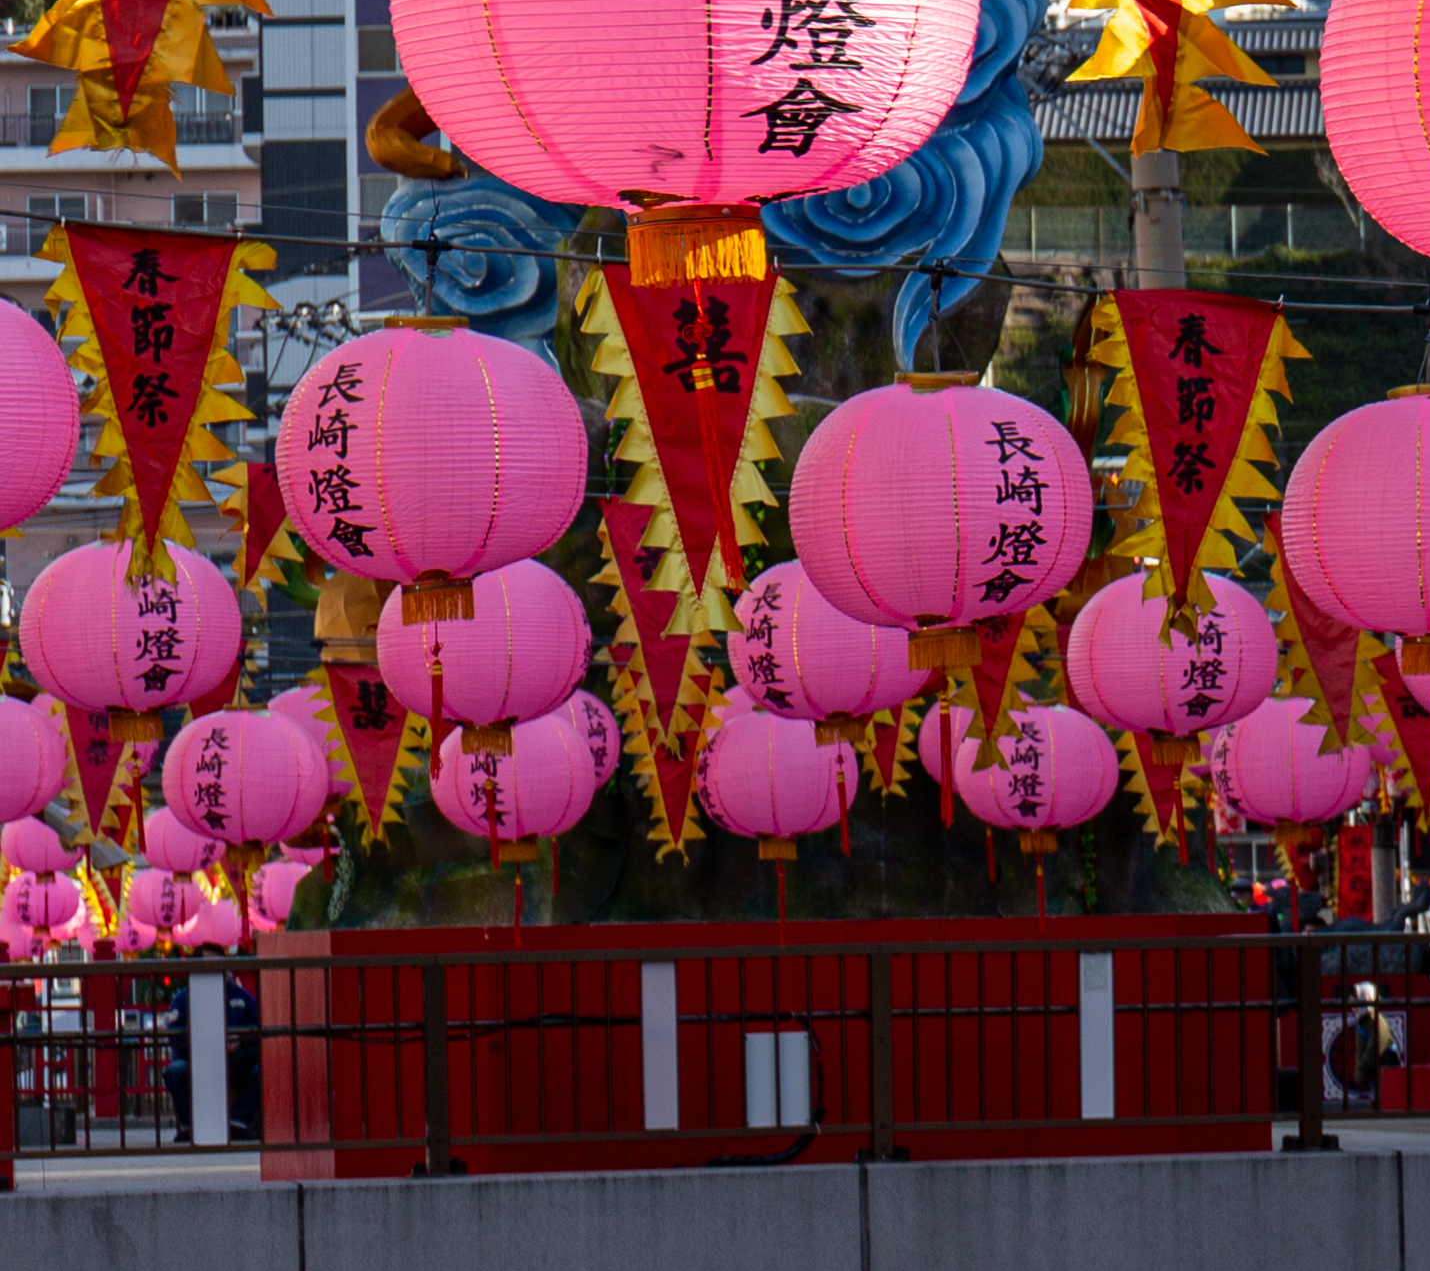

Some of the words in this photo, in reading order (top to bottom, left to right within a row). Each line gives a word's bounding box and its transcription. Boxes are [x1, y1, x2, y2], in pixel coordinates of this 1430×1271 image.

[121, 248, 180, 428] 春節祭
[1166, 314, 1224, 495] 春節祭
[307, 362, 378, 558] 長崎燈會
[972, 421, 1049, 605] 長崎燈會
[134, 578, 185, 693] 崎燈會
[746, 582, 794, 709] 長崎燈會
[194, 728, 231, 831] 長崎燈會
[1009, 721, 1046, 817] 長崎燈會
